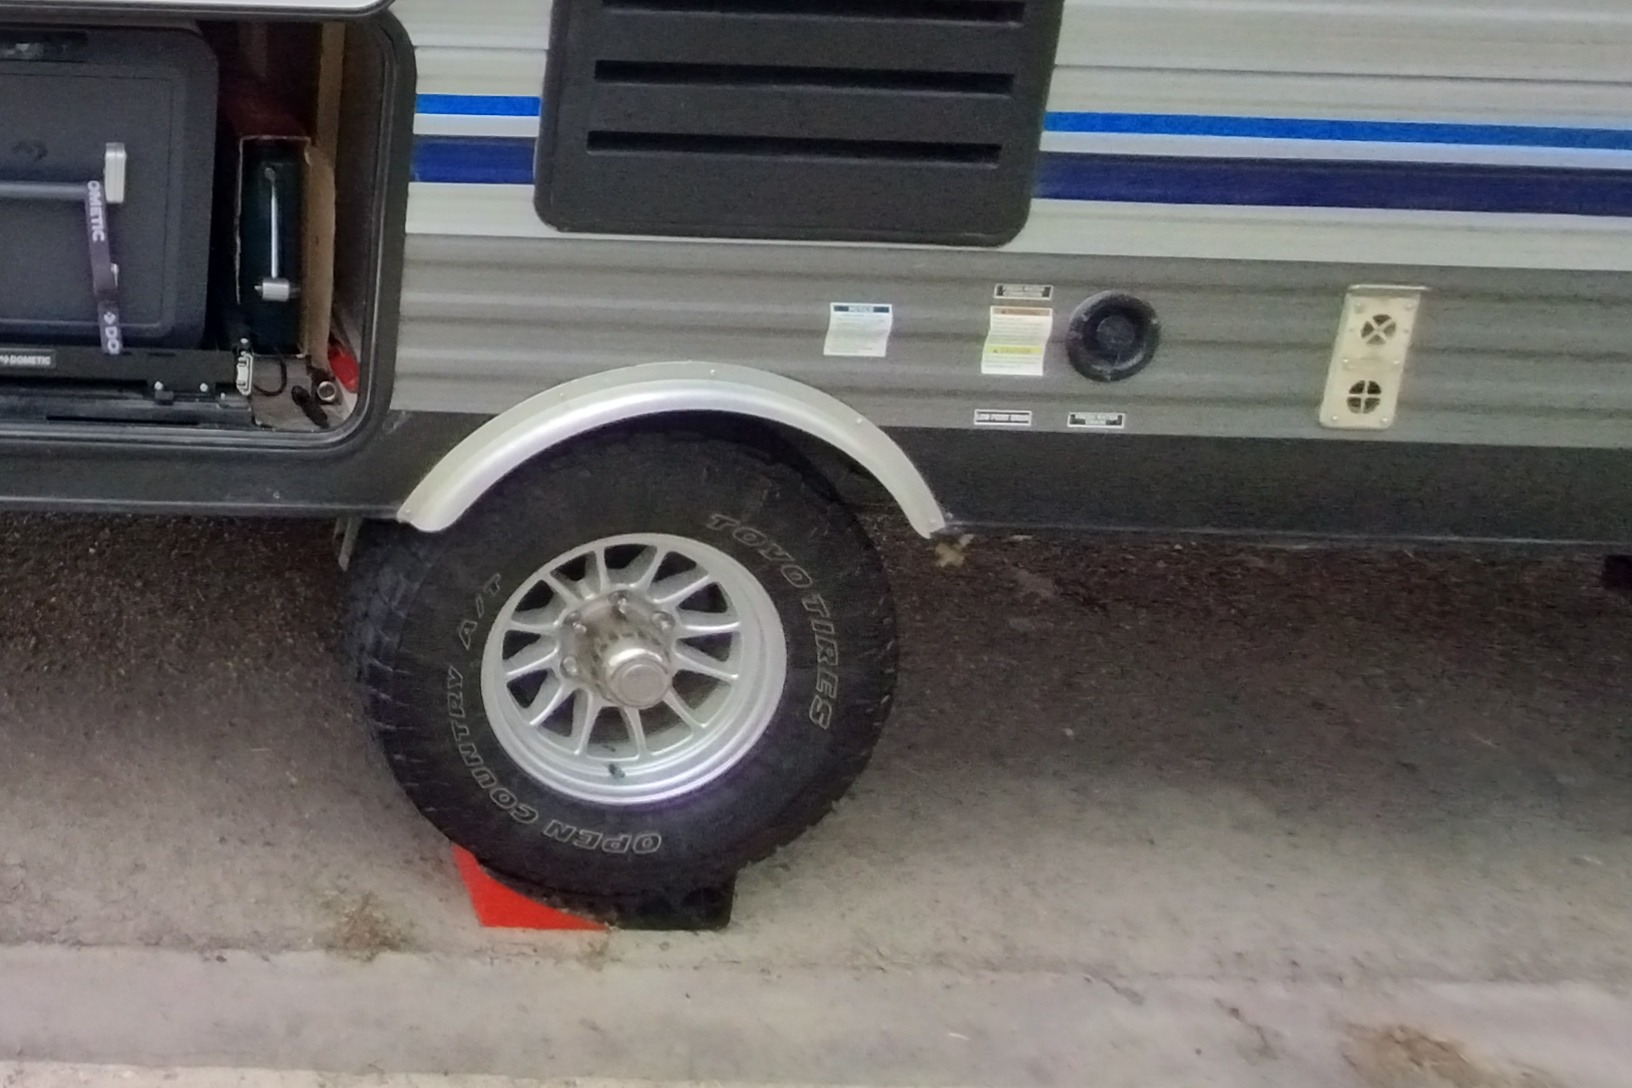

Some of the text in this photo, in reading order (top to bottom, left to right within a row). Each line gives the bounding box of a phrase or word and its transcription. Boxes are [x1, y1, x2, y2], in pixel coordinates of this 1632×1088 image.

[706, 513, 839, 730] TOYO TIRES
[447, 665, 539, 824] COUNTRY
[542, 819, 662, 854] OPEN
